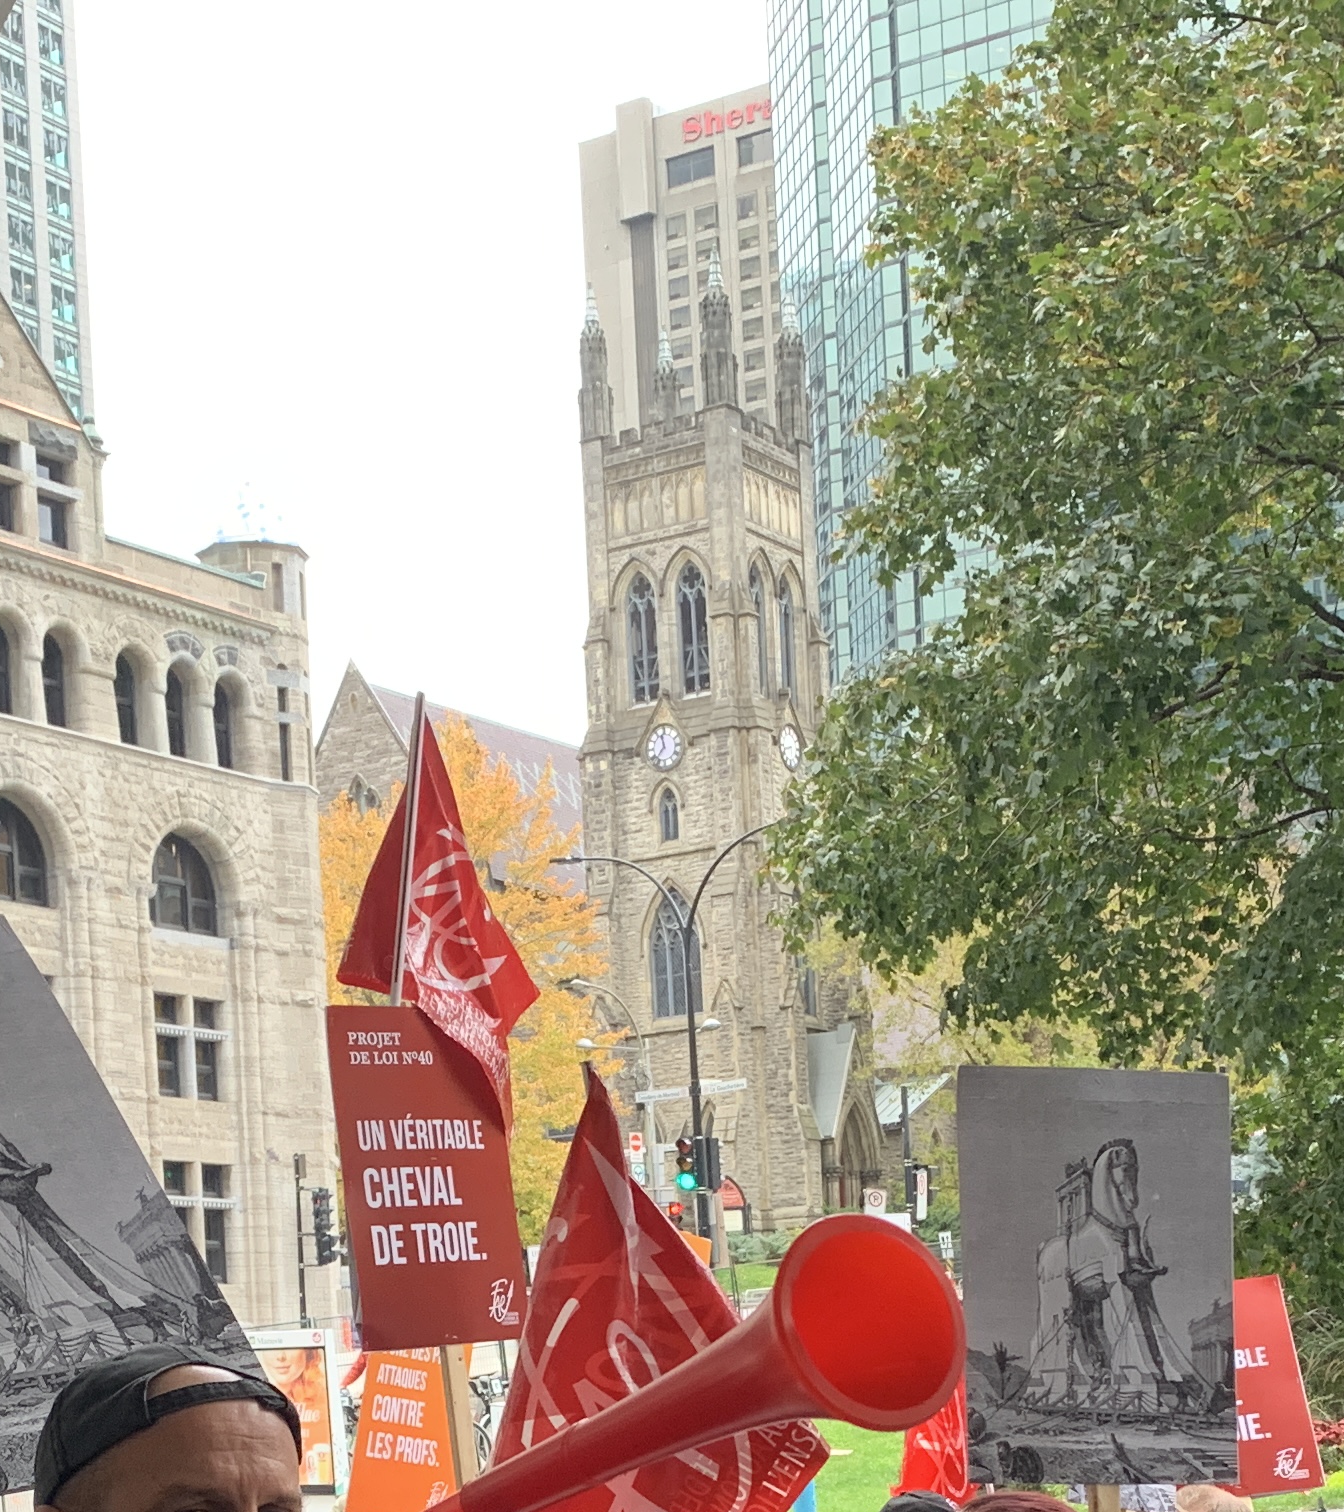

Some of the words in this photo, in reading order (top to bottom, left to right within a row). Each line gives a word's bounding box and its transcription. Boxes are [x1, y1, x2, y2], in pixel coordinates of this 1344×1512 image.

[347, 1032, 401, 1048] PROJET
[349, 1051, 371, 1065] DE
[373, 1051, 399, 1065] LOI
[356, 1120, 384, 1150] UN
[390, 1114, 485, 1151] VÉRITABLE
[363, 1166, 463, 1209] CHEVAL
[371, 1225, 408, 1266] DE
[410, 1221, 488, 1263] TROIE.
[376, 1363, 428, 1392] ATTAQUES
[372, 1394, 426, 1428] CONTRE
[366, 1431, 393, 1460] LES
[394, 1435, 440, 1468] PROFS.
